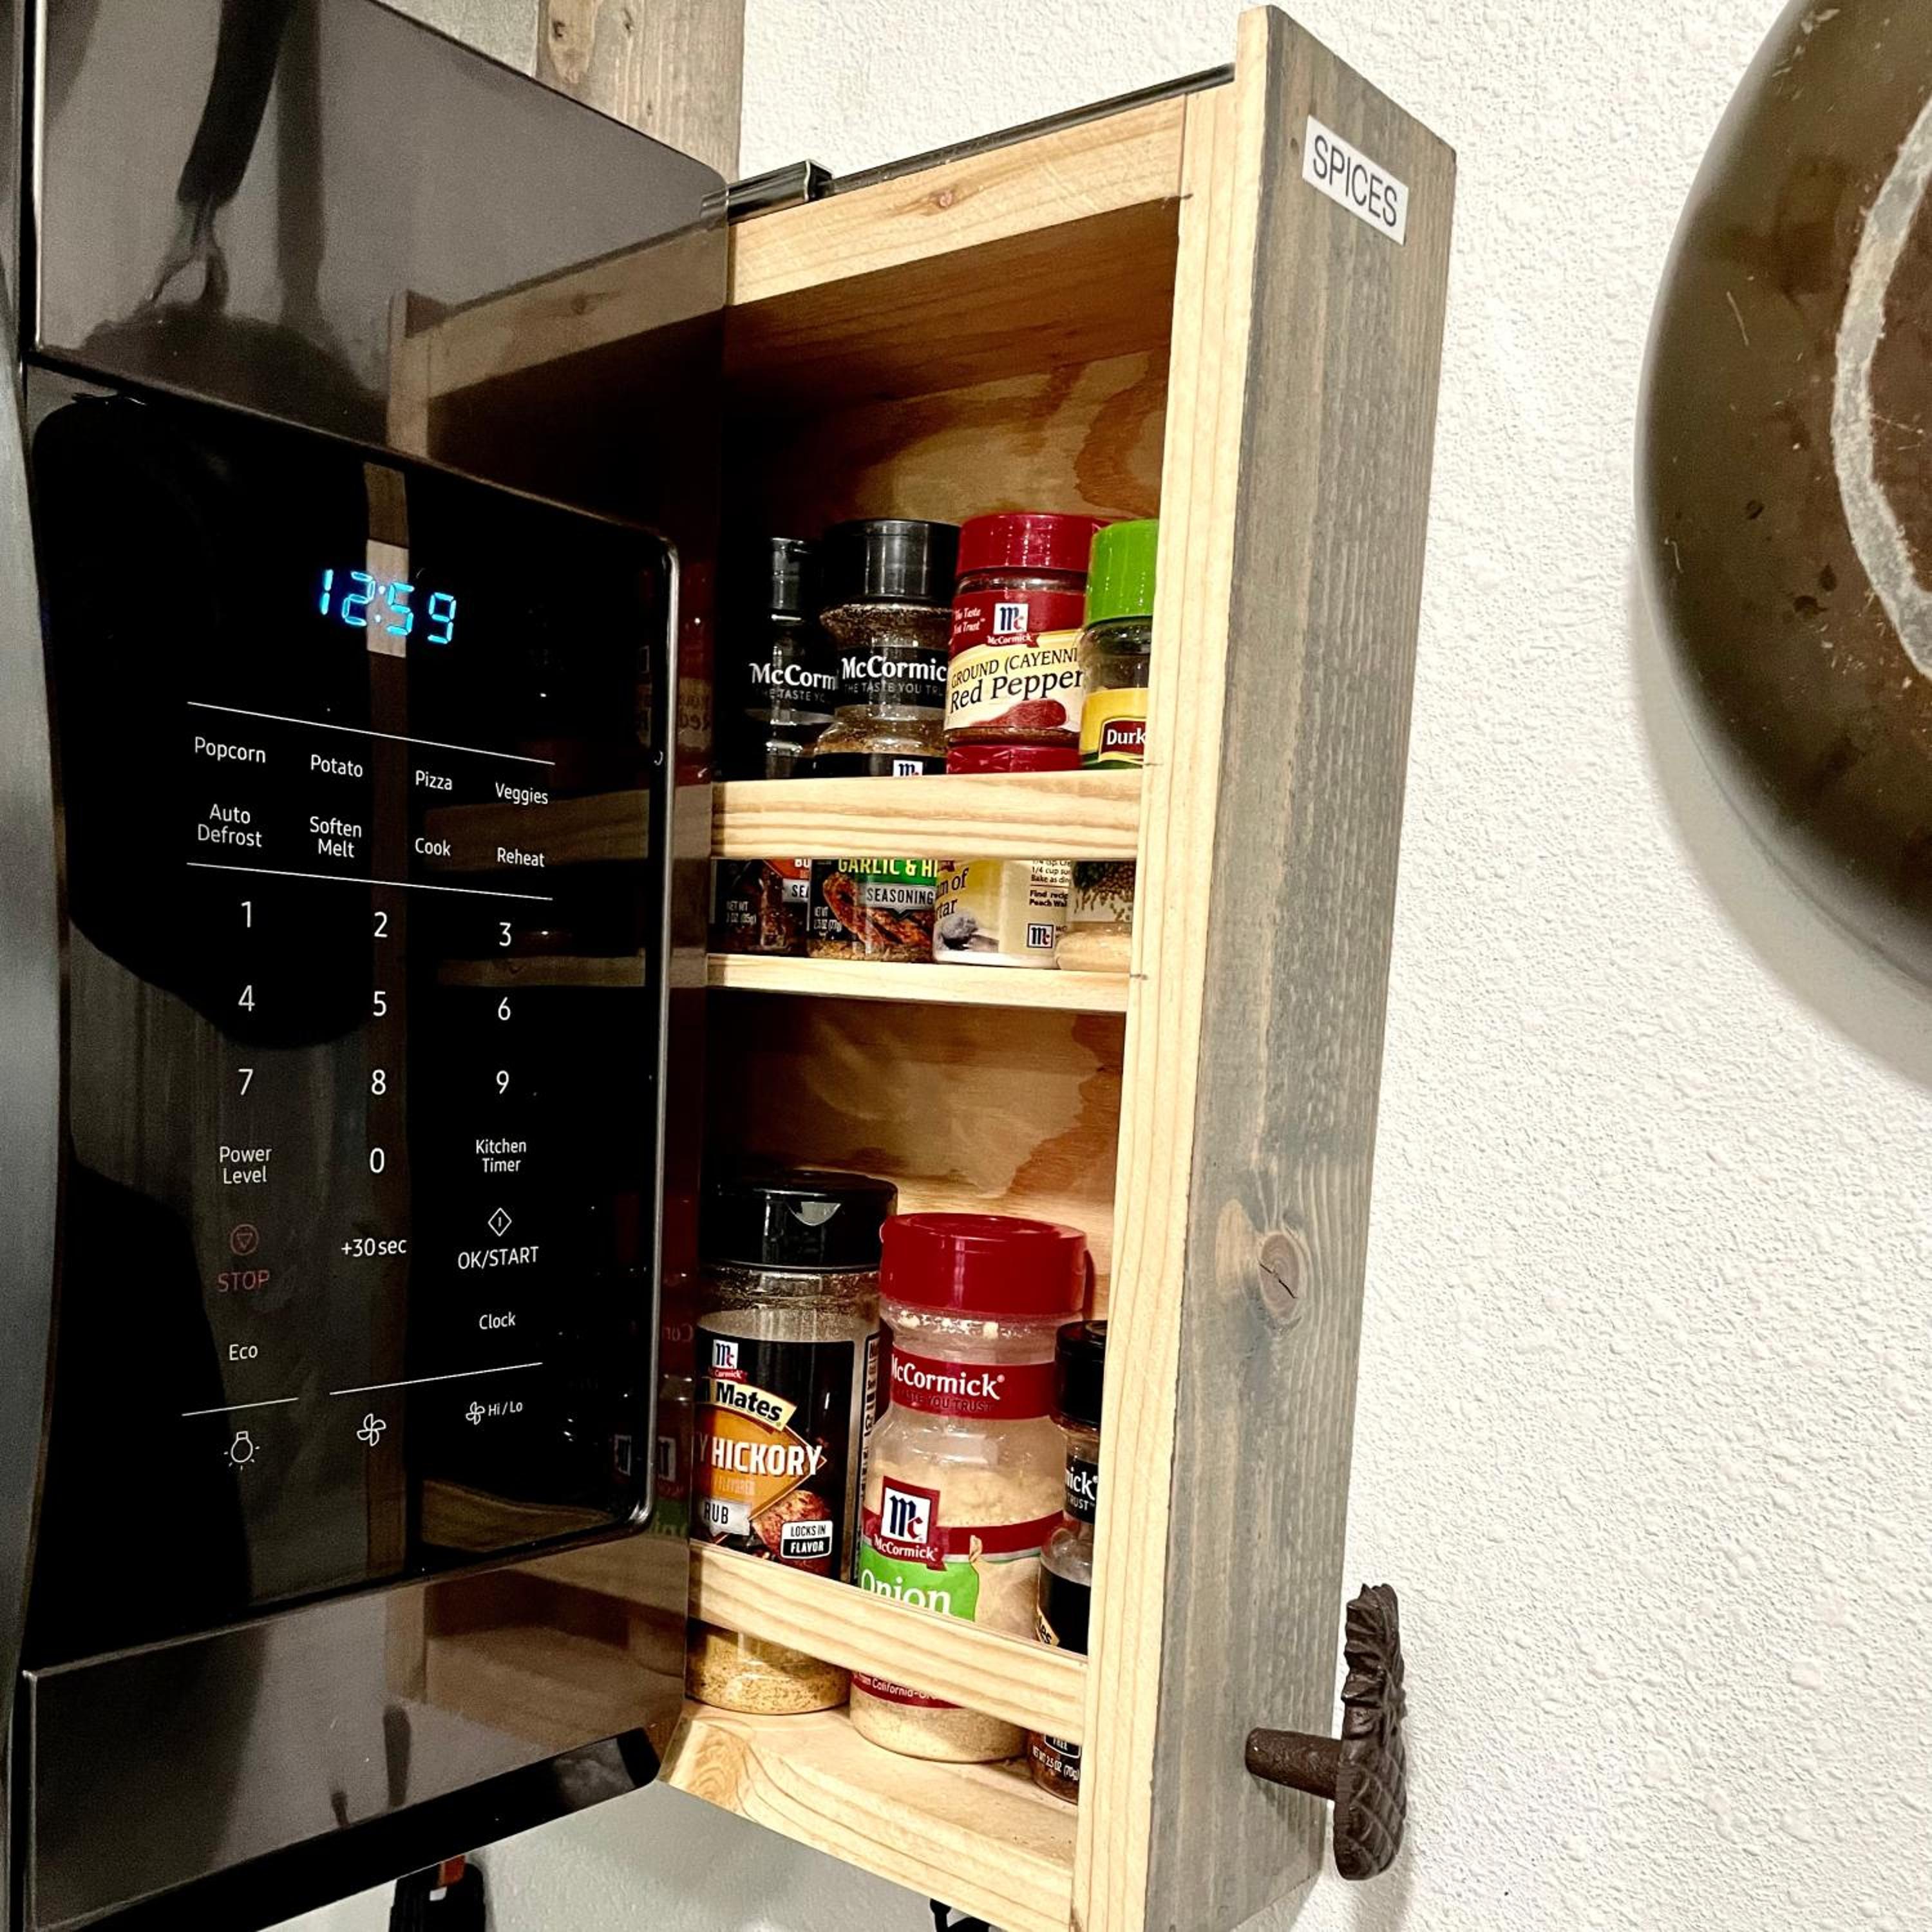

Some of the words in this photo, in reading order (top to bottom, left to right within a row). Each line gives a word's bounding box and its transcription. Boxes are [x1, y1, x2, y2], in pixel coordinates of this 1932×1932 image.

[1313, 135, 1397, 227] SPICES
[320, 569, 457, 644] 12:59
[987, 632, 1032, 645] McCormick
[951, 659, 999, 688] GROUND
[862, 682, 895, 694] TASTE
[898, 683, 922, 694] YOU
[950, 679, 982, 713] Red
[990, 670, 1084, 701] Pepper
[1106, 727, 1146, 745] Durk
[195, 736, 266, 763] Popcorn
[310, 754, 363, 777] Potato
[415, 770, 453, 790] Pizza
[495, 782, 548, 806] Veggies
[209, 803, 251, 824] Auto
[198, 824, 262, 848] Defrost
[310, 816, 362, 838] Soften
[318, 838, 355, 858] Melt
[415, 838, 451, 856] Cook
[497, 847, 545, 867] Reheat
[838, 859, 900, 875] GARLIC
[905, 860, 916, 876] &
[922, 860, 938, 878] H
[952, 867, 969, 890] of
[866, 887, 933, 905] SEASONING
[241, 901, 251, 928] 1
[374, 911, 388, 938] 2
[499, 922, 511, 947] 3
[238, 985, 255, 1012] 4
[373, 990, 387, 1017] 5
[498, 997, 511, 1021] 6
[238, 1068, 253, 1095] 7
[371, 1069, 386, 1095] 8
[496, 1070, 509, 1094] 9
[220, 1146, 272, 1163] Power
[476, 1138, 526, 1154] Kitchen
[370, 1147, 384, 1173] 0
[482, 1157, 521, 1173] Timer
[223, 1165, 267, 1184] Level
[457, 1247, 539, 1269] OK/START
[217, 1270, 270, 1293] STOP
[478, 1311, 516, 1330] Clock
[229, 1343, 258, 1361] Eco
[891, 1353, 1000, 1400] McCormick
[716, 1381, 783, 1421] Mates
[711, 1437, 822, 1477] HICKORY
[705, 1502, 728, 1524] RUB
[790, 1526, 816, 1537] LOCKS
[818, 1524, 826, 1535] IN
[790, 1541, 824, 1554] FLAVOR
[874, 1534, 936, 1561] McCormick
[861, 1569, 952, 1615] Onion
